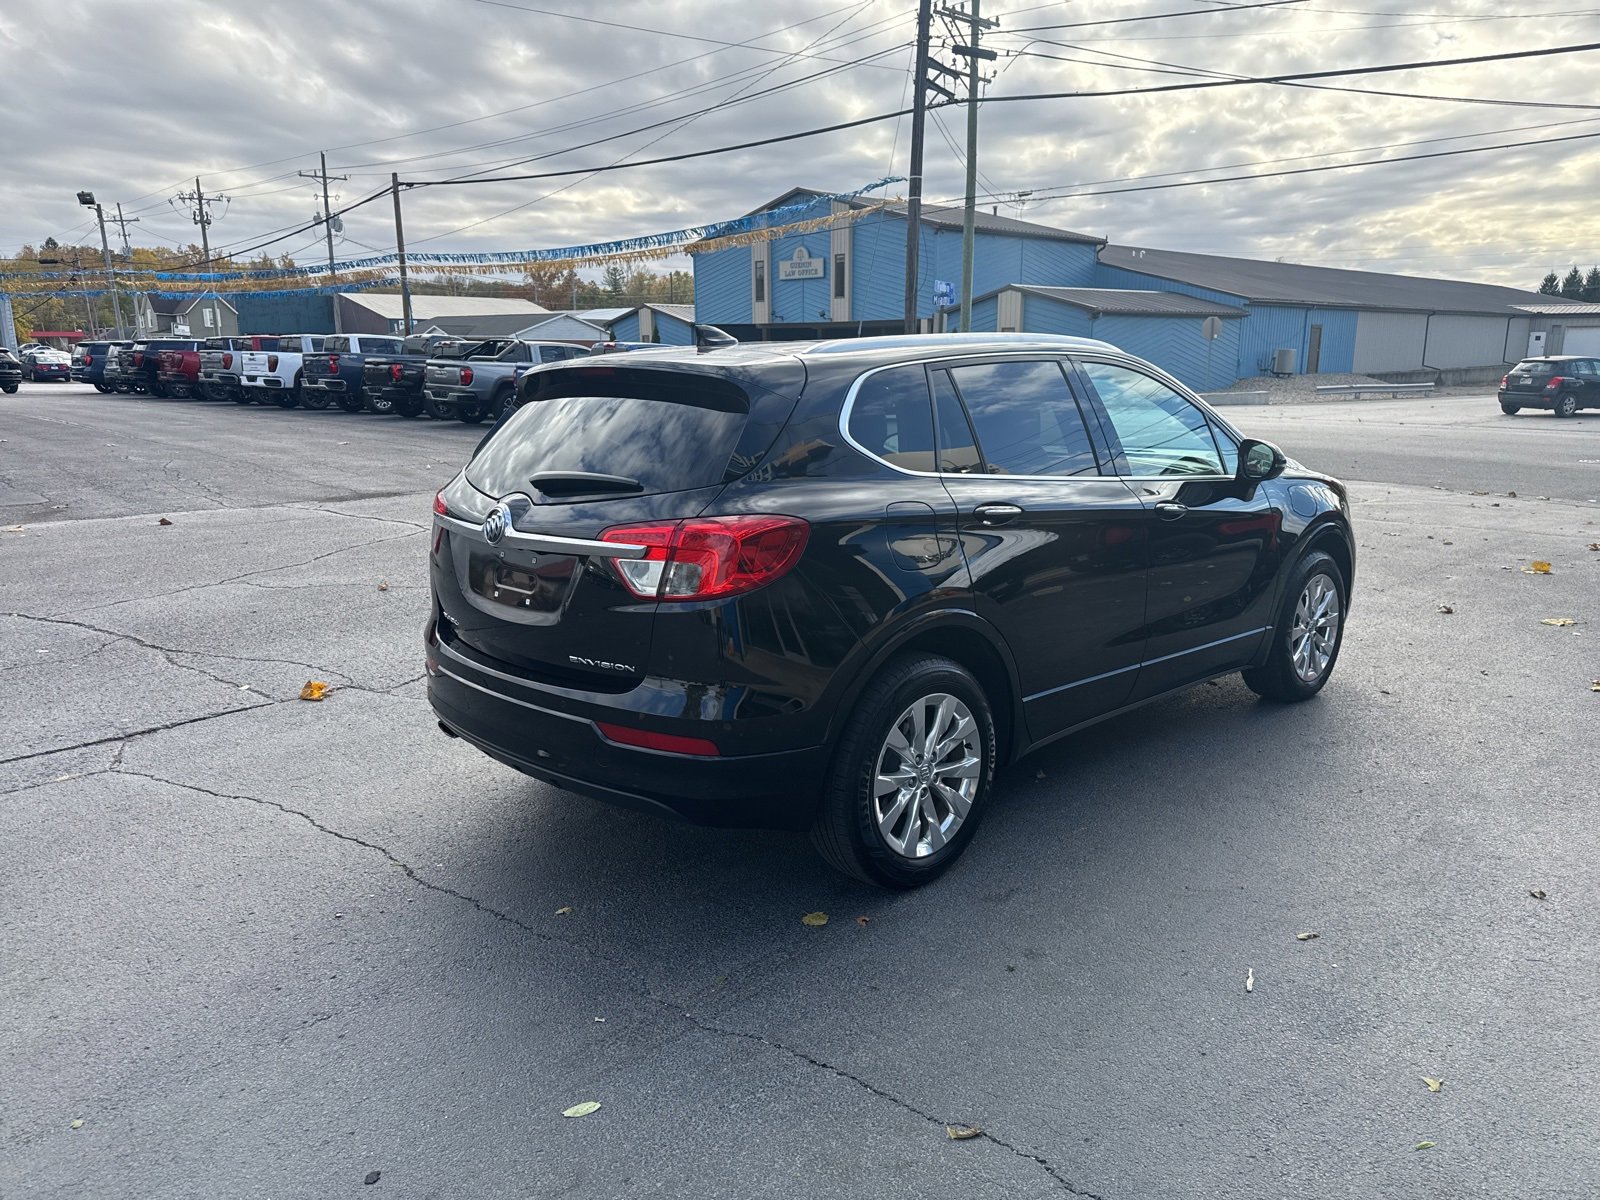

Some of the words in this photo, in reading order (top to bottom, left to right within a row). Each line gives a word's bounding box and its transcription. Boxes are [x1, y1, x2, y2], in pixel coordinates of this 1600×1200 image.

[784, 269, 797, 277] LAW
[797, 268, 818, 276] OFFICE
[569, 655, 635, 672] ENVISION
